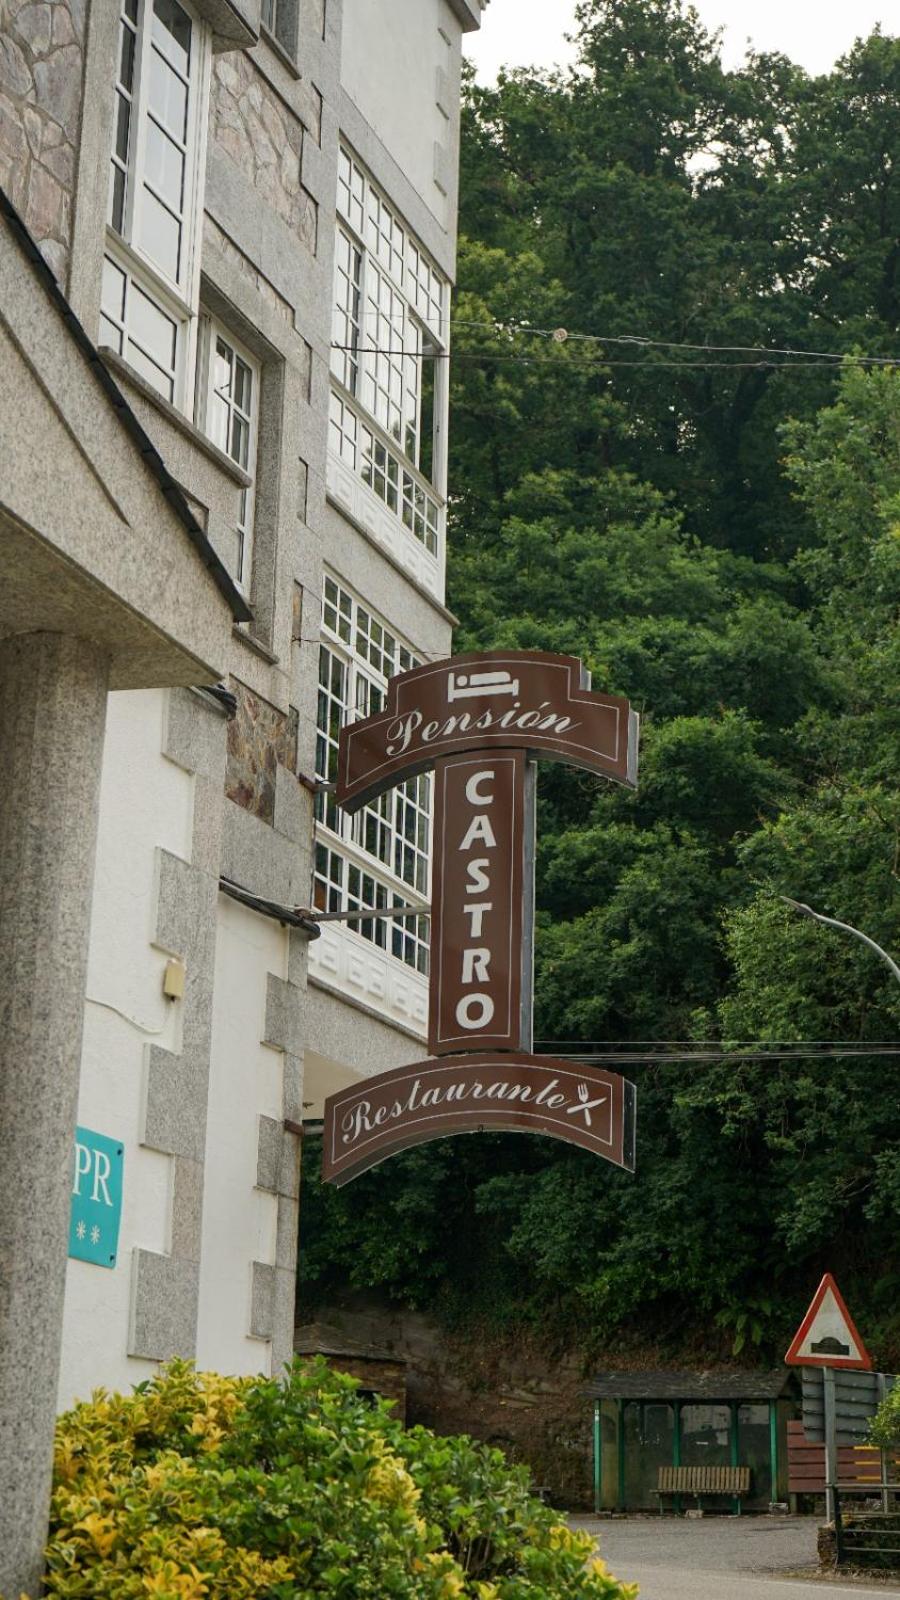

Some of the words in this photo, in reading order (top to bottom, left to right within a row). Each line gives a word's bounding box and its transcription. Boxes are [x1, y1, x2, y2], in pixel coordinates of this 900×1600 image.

[385, 702, 582, 756] Pensión
[457, 770, 497, 1030] CASTRO
[342, 1078, 566, 1144] Restaurante
[72, 1143, 114, 1207] PR
